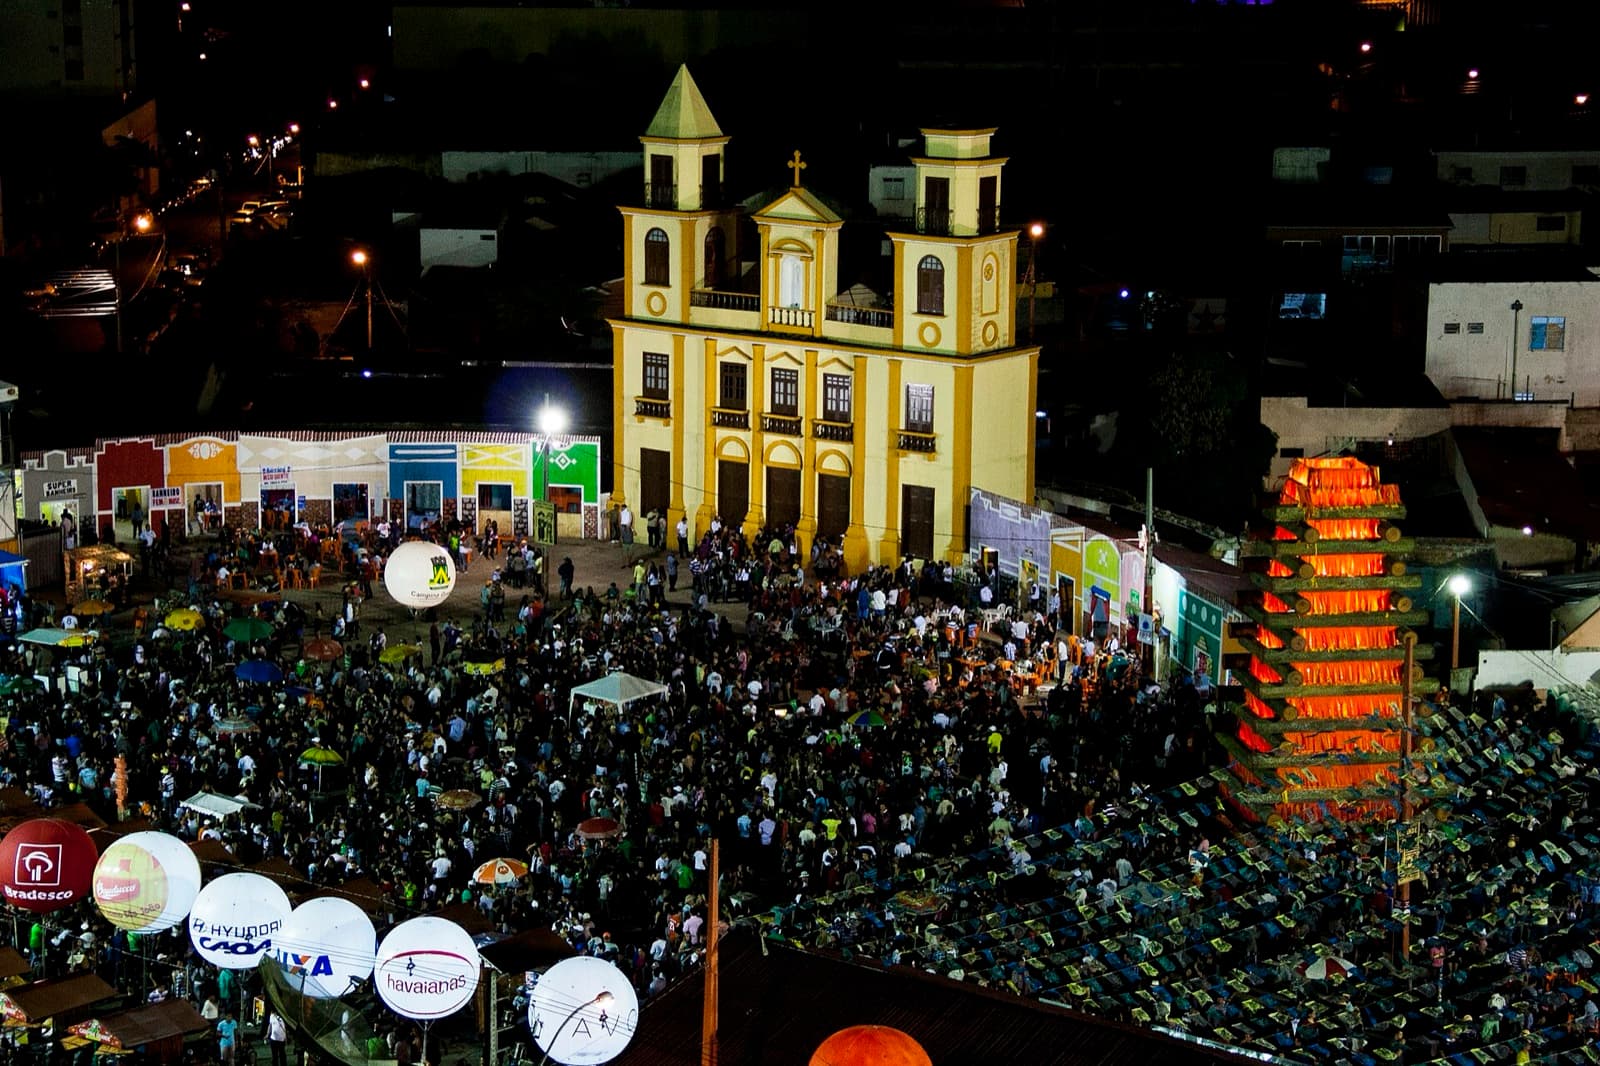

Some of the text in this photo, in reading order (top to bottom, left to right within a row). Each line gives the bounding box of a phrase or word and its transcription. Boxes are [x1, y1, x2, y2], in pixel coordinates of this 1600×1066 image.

[47, 480, 72, 490] SUPER
[4, 885, 73, 900] Bradesco
[211, 919, 282, 938] HYUNDAI
[387, 973, 466, 995] havaianas
